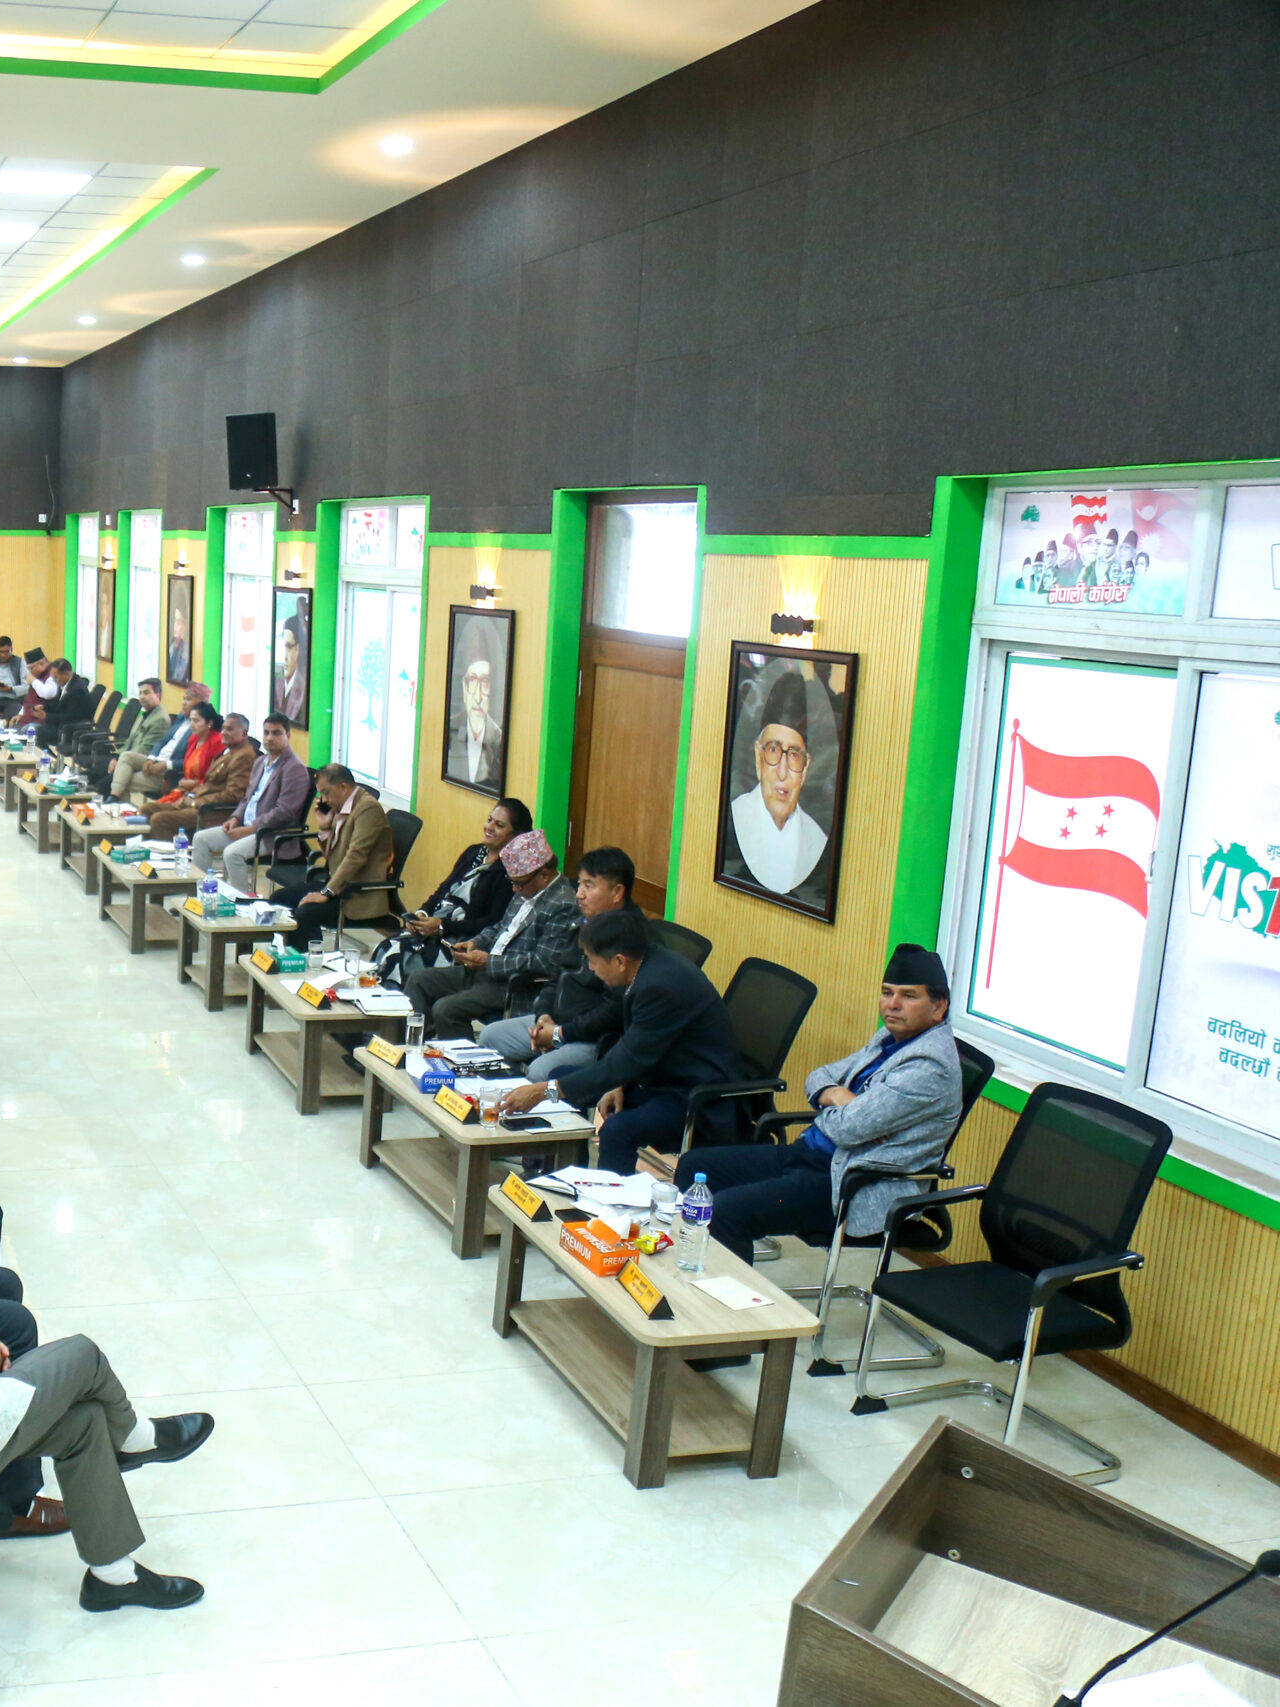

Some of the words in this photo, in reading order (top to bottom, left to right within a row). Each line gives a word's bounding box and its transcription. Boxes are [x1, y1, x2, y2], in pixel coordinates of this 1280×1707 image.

[1048, 582, 1087, 604] नेपाली
[1207, 1016, 1267, 1049] बदलियो
[424, 1077, 454, 1086] PREMIUM
[561, 1229, 592, 1262] PREMIUM
